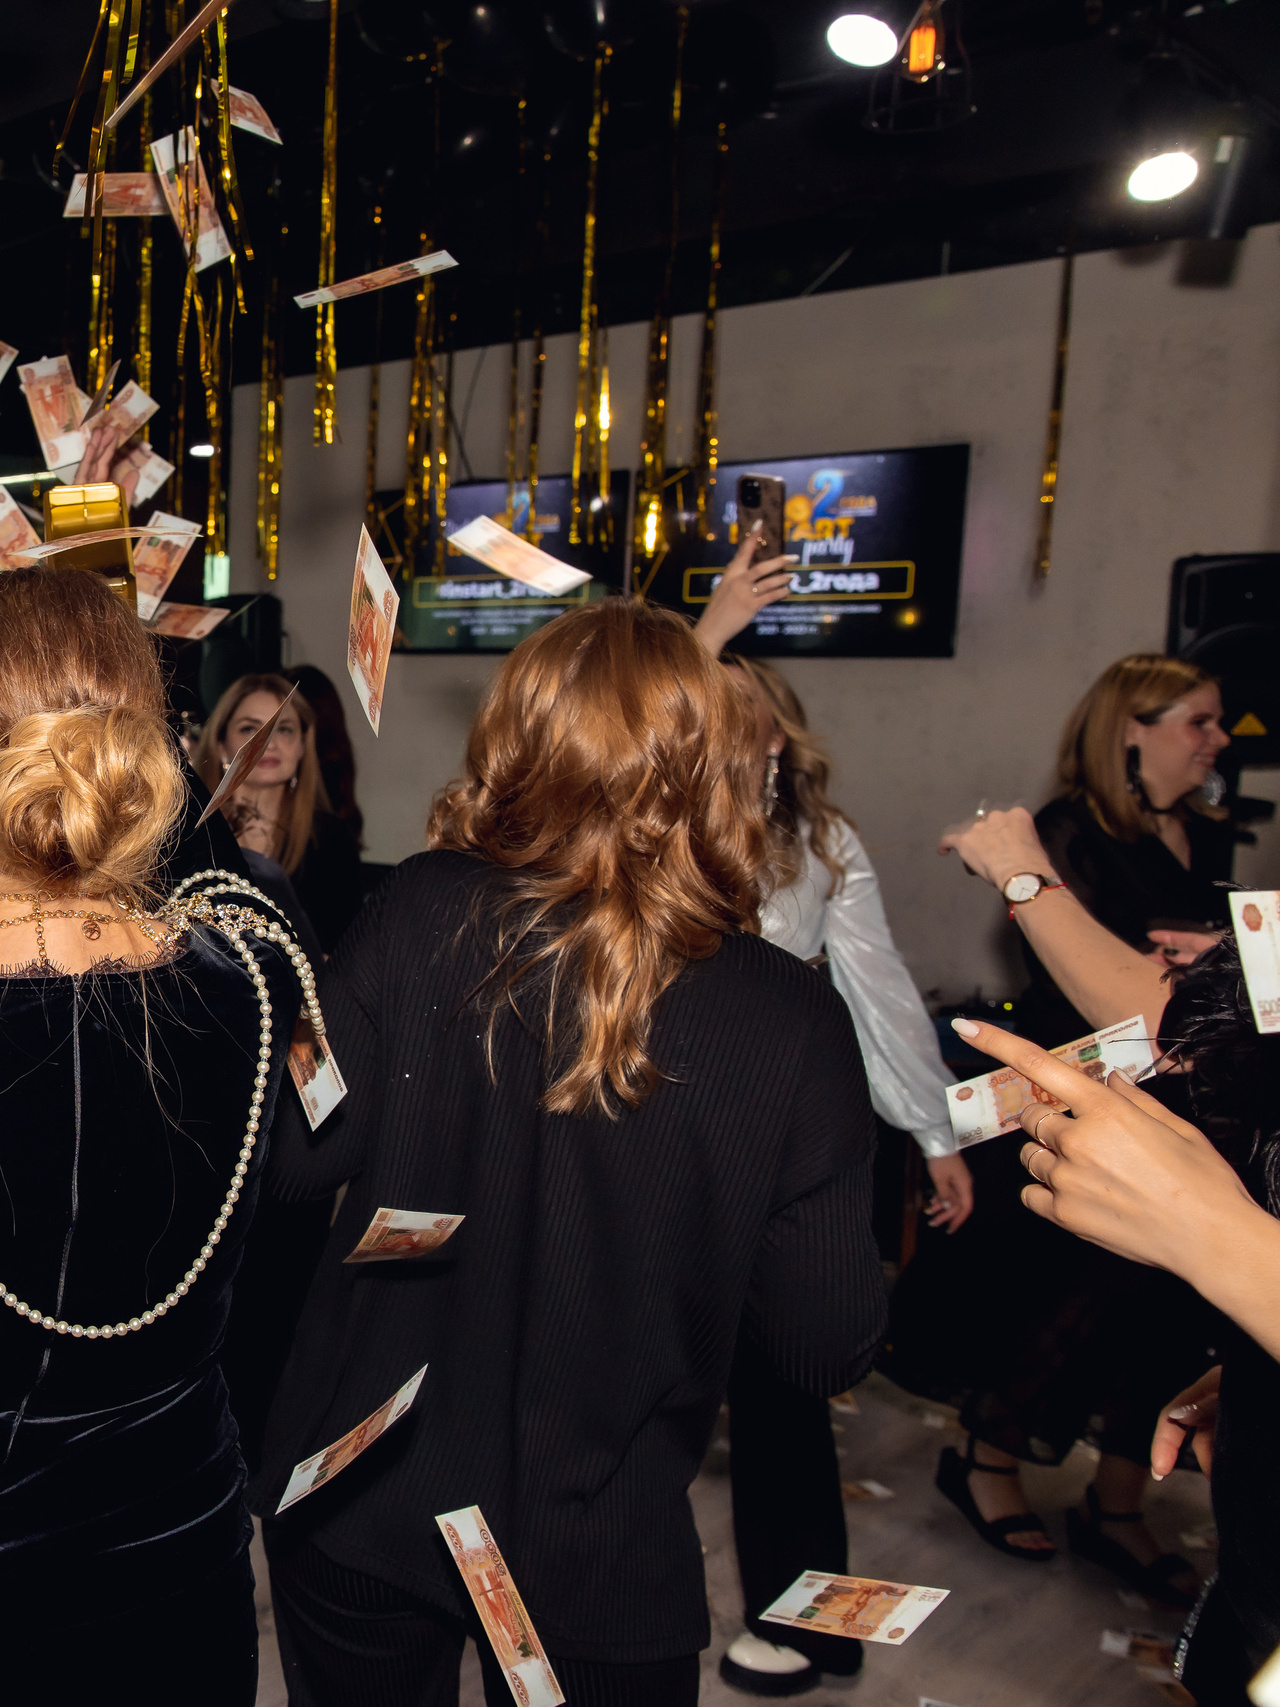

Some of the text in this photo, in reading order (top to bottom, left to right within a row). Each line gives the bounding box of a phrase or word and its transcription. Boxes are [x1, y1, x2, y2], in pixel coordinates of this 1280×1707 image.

[1070, 1038, 1096, 1051] БАНКА
[1098, 1020, 1139, 1040] ПРИКОЛОВ
[327, 1058, 344, 1092] ПРИКОЛОВ
[445, 1524, 462, 1552] 5000
[478, 1527, 507, 1576] 5000
[510, 1672, 528, 1704] 5000
